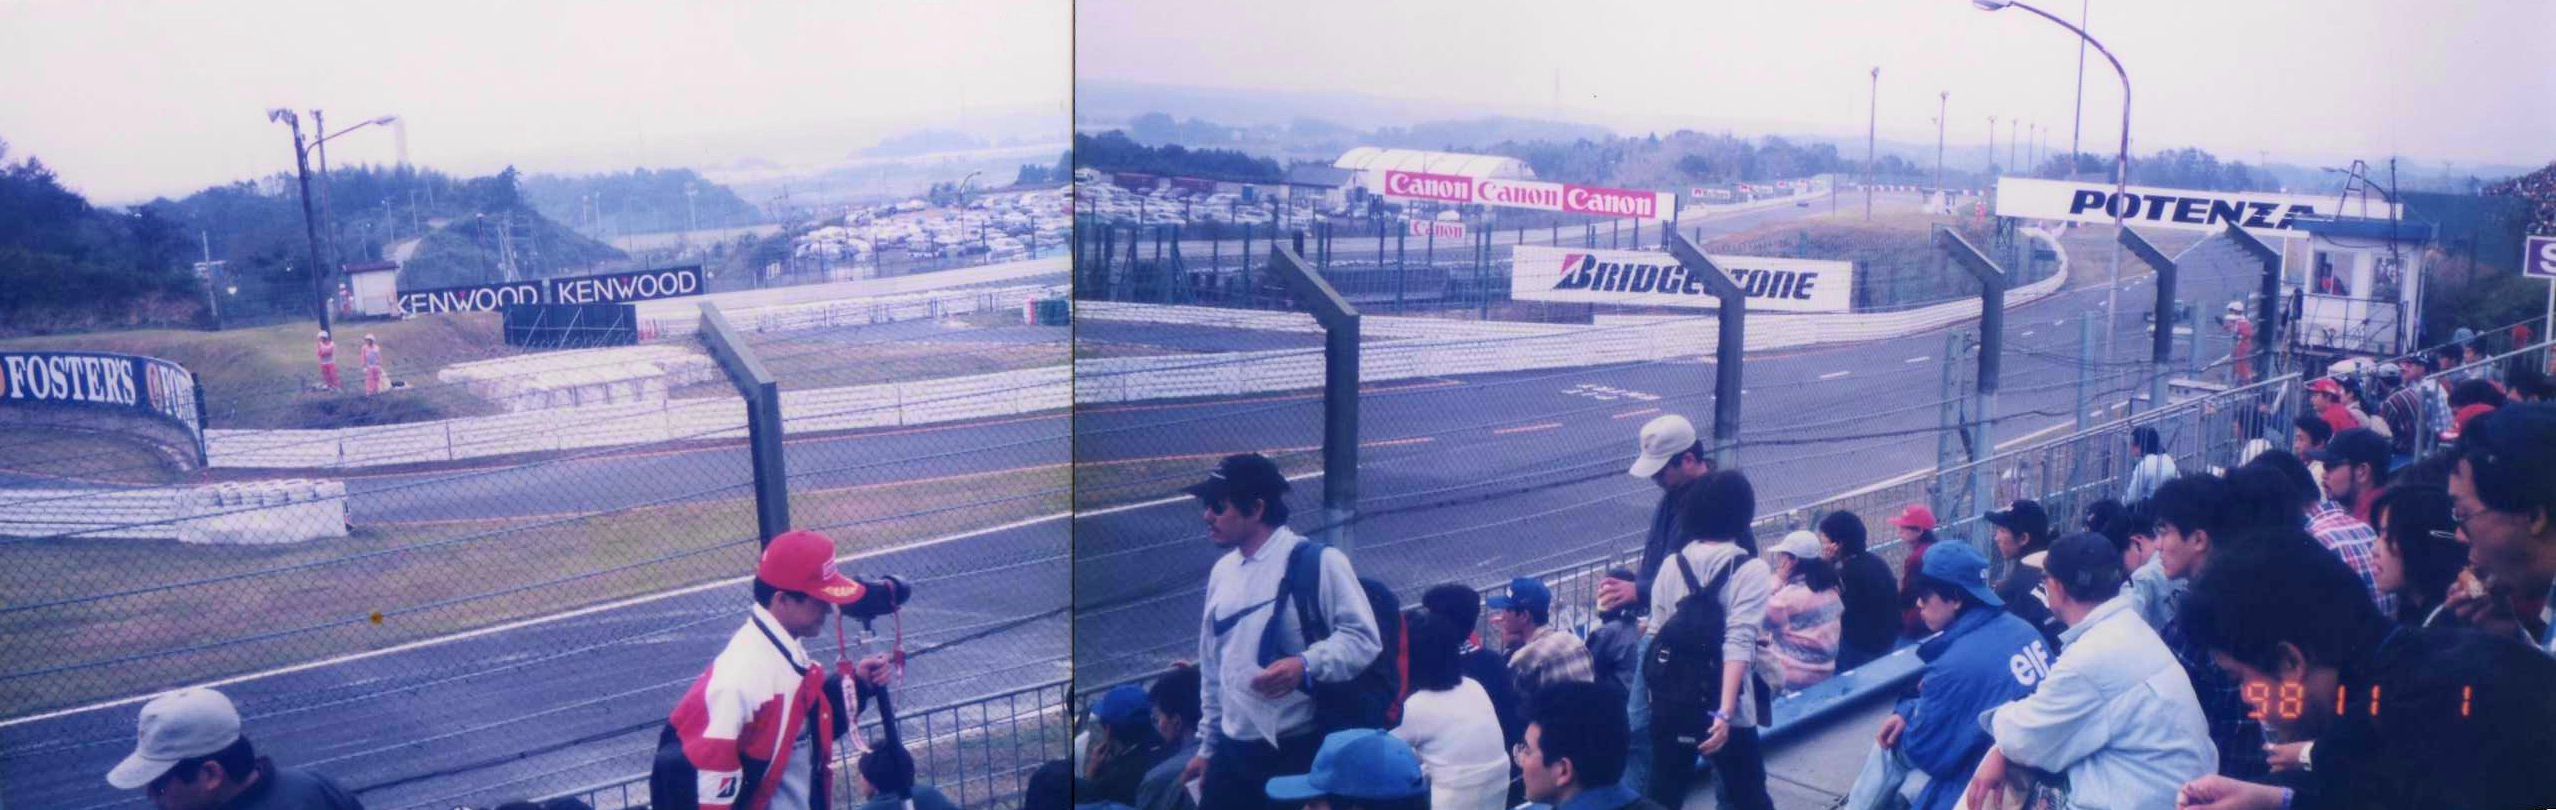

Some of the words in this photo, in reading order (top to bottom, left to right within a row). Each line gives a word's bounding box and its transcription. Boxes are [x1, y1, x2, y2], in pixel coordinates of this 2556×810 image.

[1389, 172, 1470, 200] Canon
[1478, 180, 1558, 206] Canon
[1568, 190, 1651, 215] Canon
[2069, 189, 2315, 229] POTENZA
[558, 271, 698, 304] KENWOOD
[1552, 254, 1818, 300] BRIDGETONE
[397, 285, 538, 315] KENWOOD
[4, 355, 137, 407] FOSTER'S
[2009, 640, 2050, 686] elf
